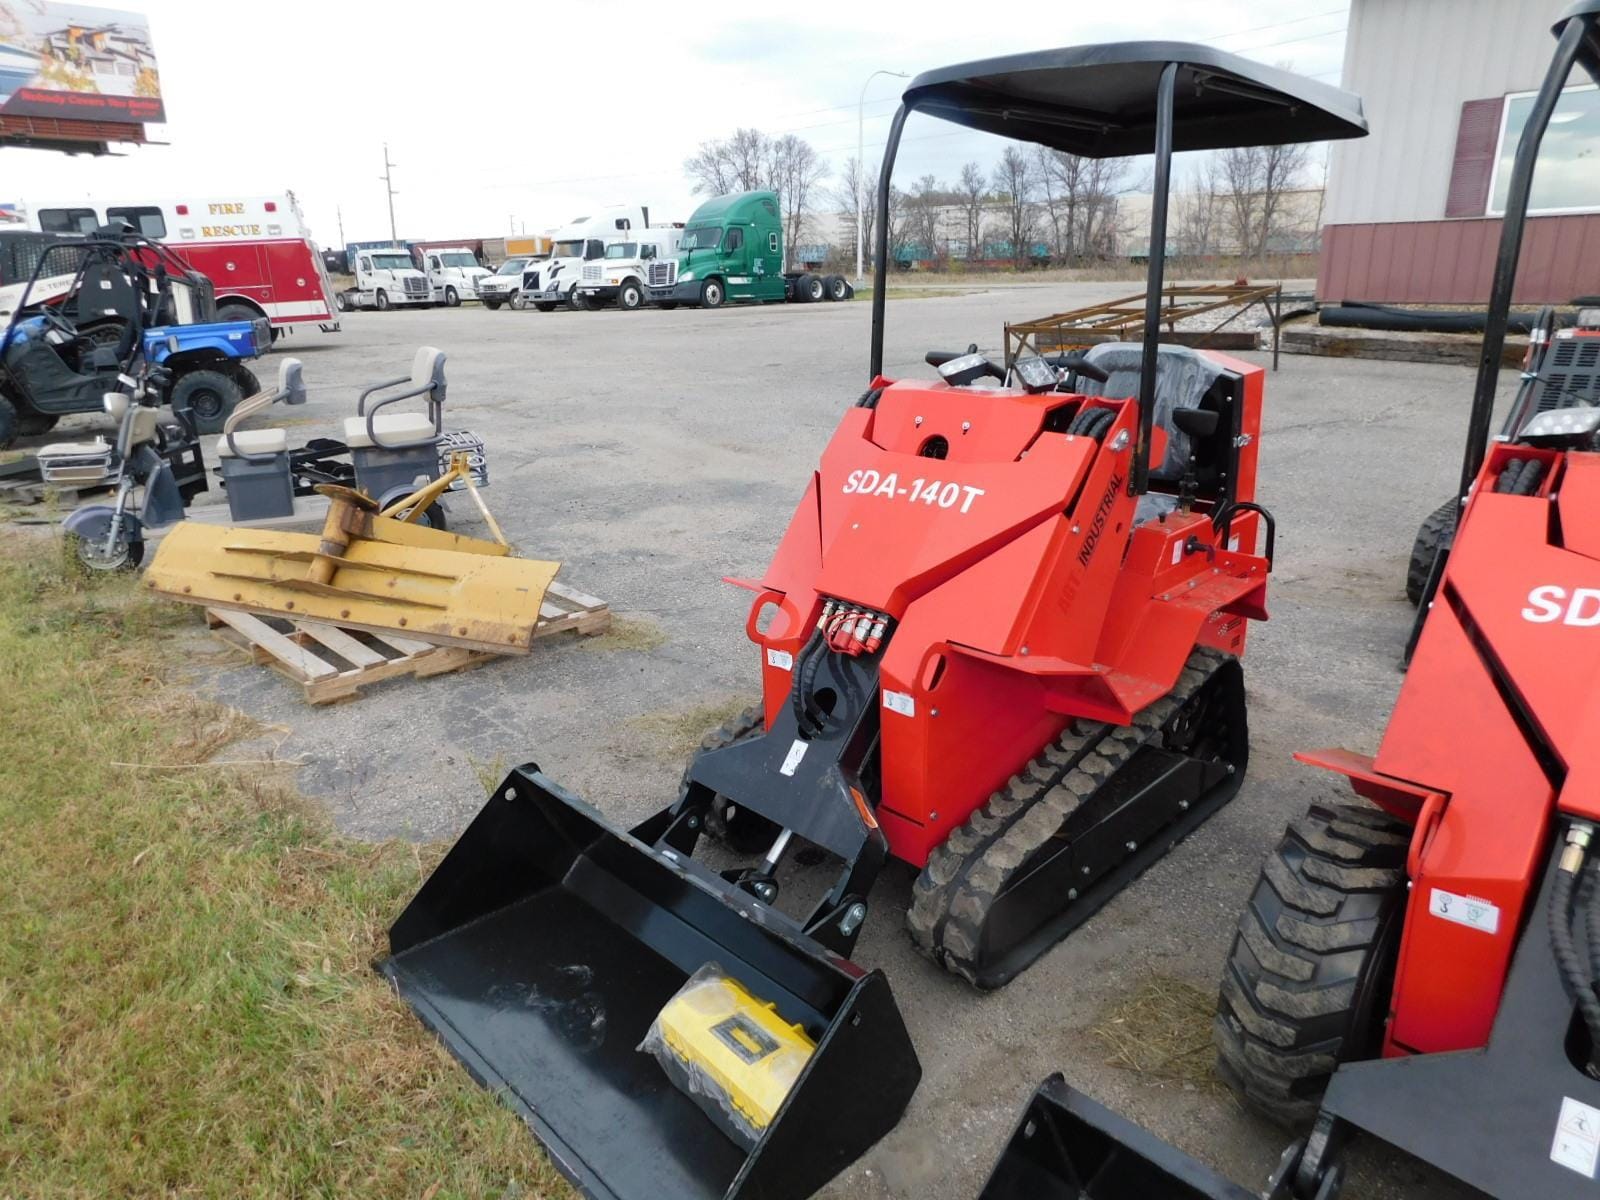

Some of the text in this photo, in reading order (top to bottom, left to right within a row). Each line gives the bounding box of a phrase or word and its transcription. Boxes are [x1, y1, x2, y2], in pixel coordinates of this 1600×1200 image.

[208, 203, 245, 215] FIRE
[202, 224, 261, 237] RESCUE
[842, 470, 986, 514] SDA-140T
[1078, 473, 1123, 567] INDUSTRIAL
